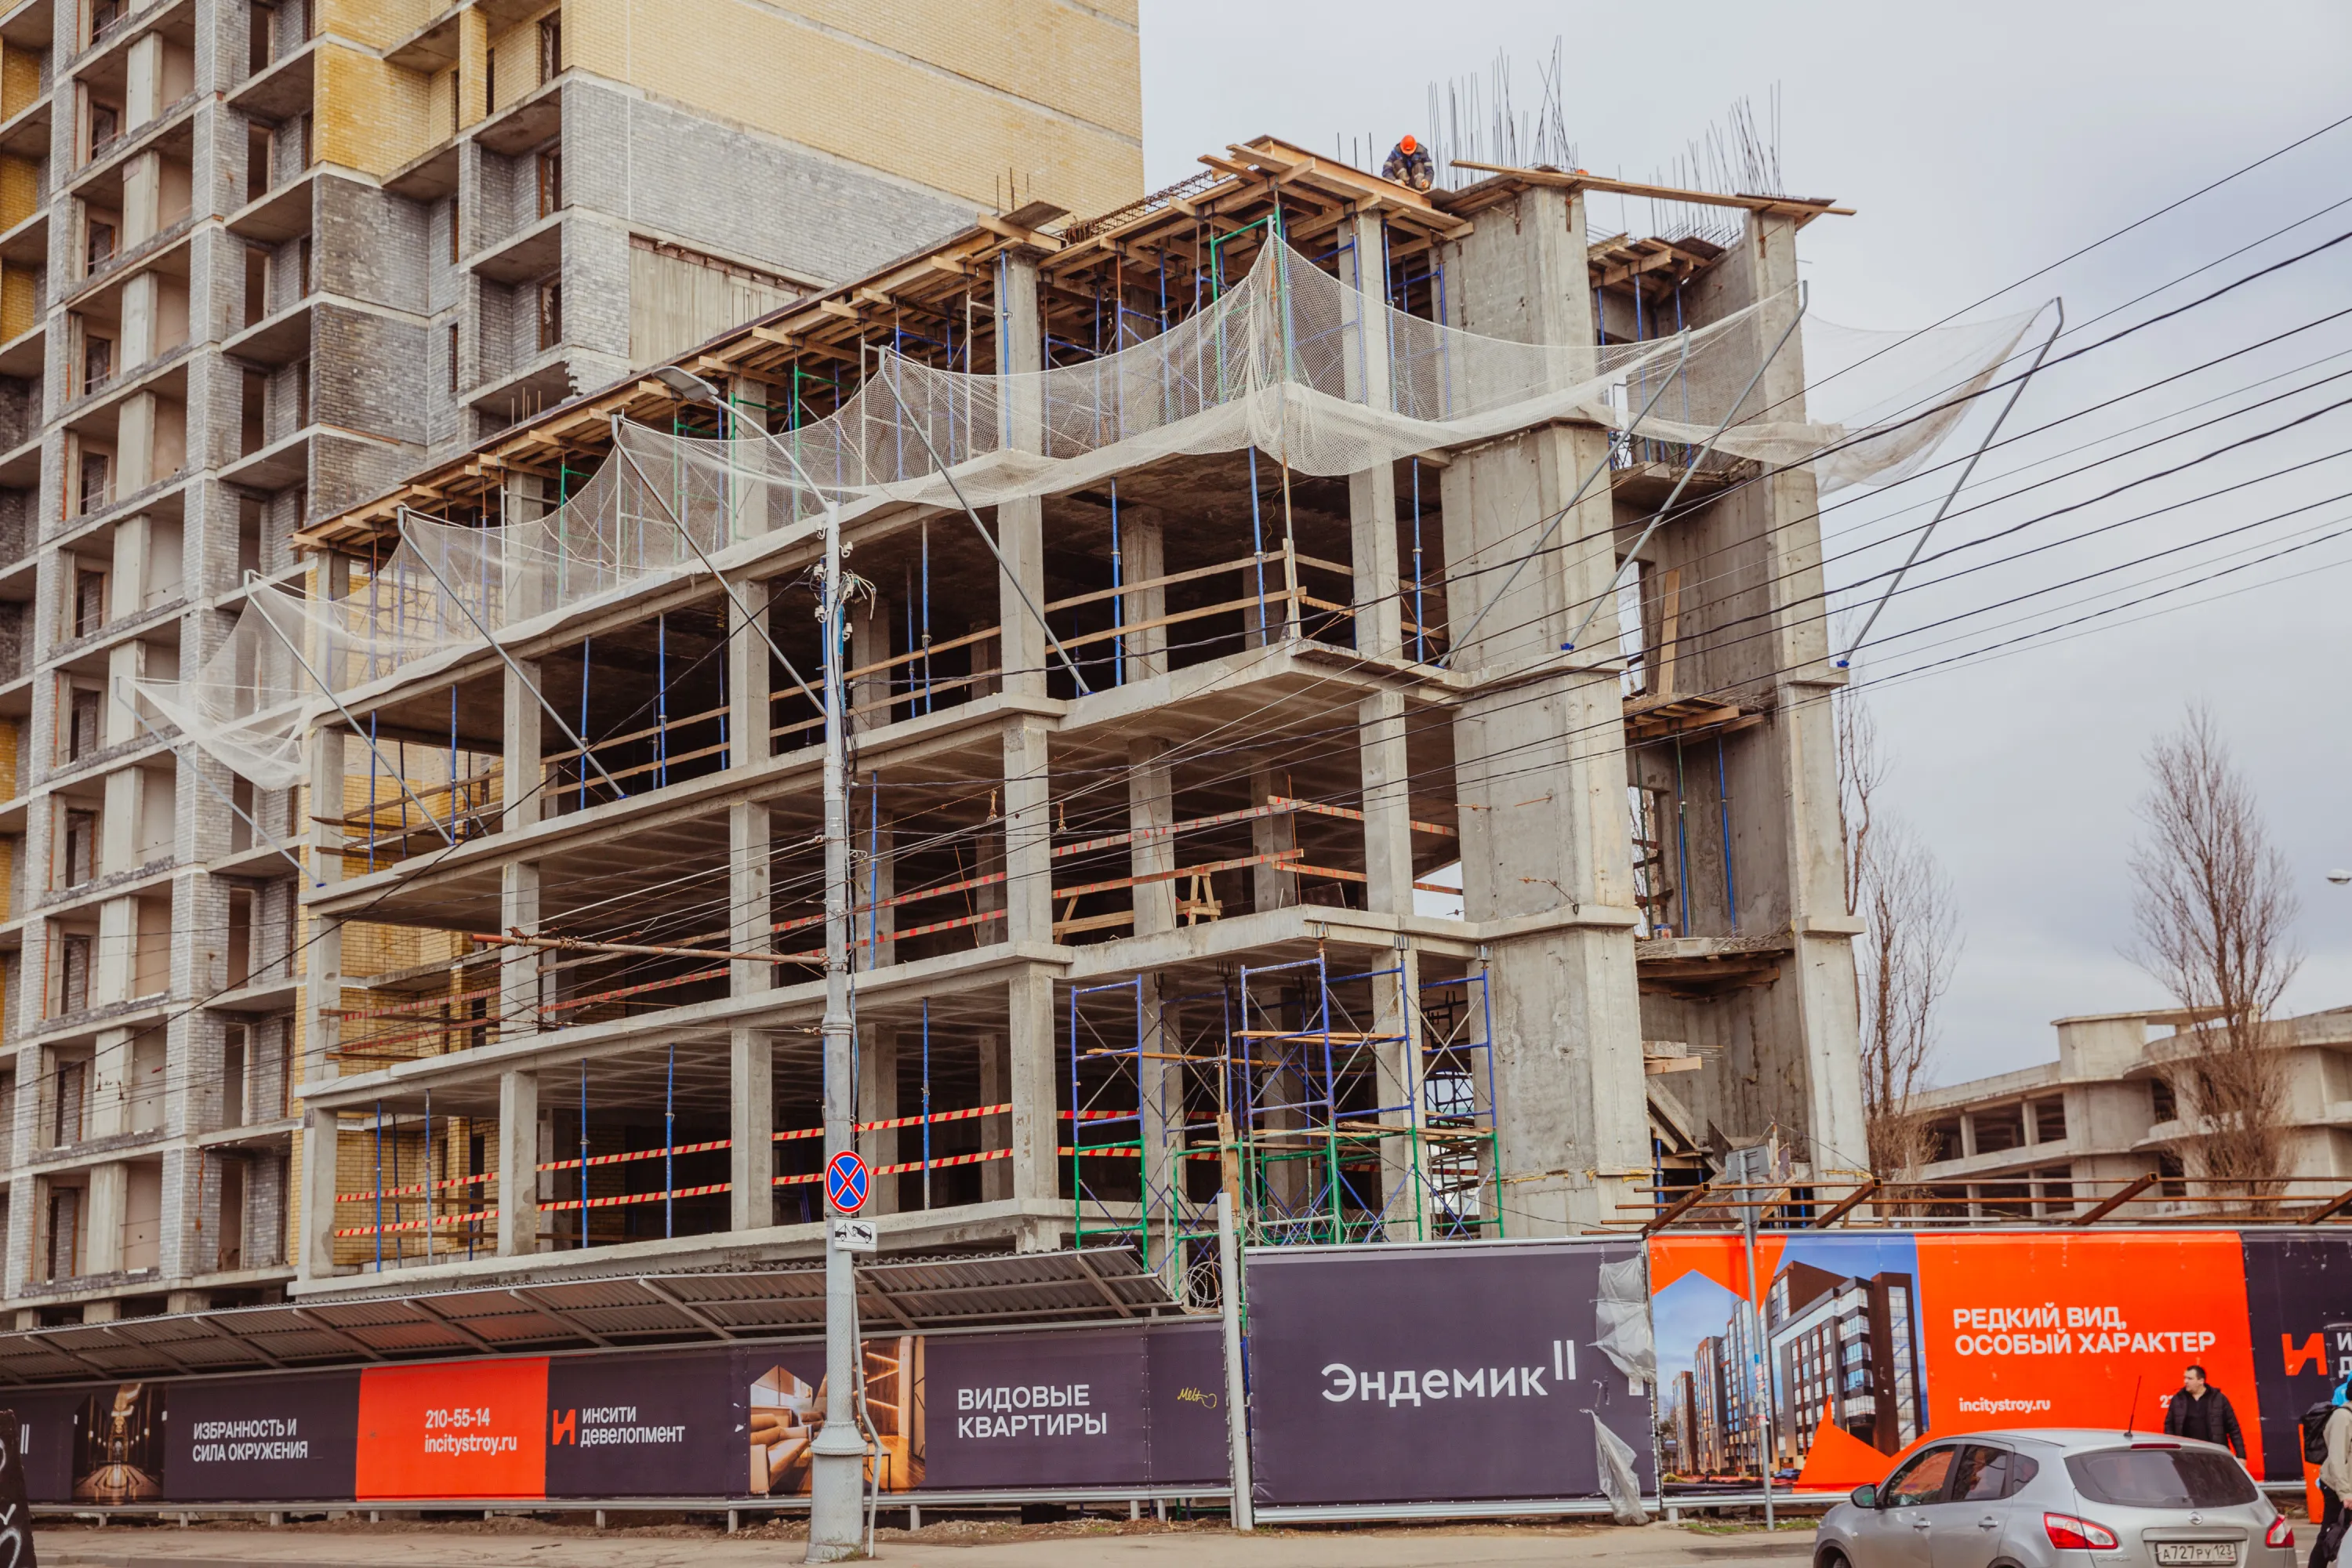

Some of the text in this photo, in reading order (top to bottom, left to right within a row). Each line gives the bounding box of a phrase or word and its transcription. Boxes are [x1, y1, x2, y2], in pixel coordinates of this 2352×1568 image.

[1953, 1302, 2127, 1332] РЕДКИЙ ВИД,
[1955, 1328, 2216, 1356] ОСОБЫЙ ХАРАКТЕР
[1321, 1363, 1548, 1407] Эндемик
[958, 1384, 1090, 1413] ВИДОВЫЕ
[1958, 1397, 2051, 1414] incitystroy.ru
[194, 1418, 297, 1439] ИЗБРАННОСТЬ И
[425, 1407, 490, 1428] 210-55-14
[958, 1412, 1107, 1439] КВАРТИРЫ
[192, 1441, 308, 1462] СИЛА ОКРУЖЕНИЯ
[424, 1433, 517, 1457] incitystroy.ru
[2213, 1544, 2232, 1555] 123
